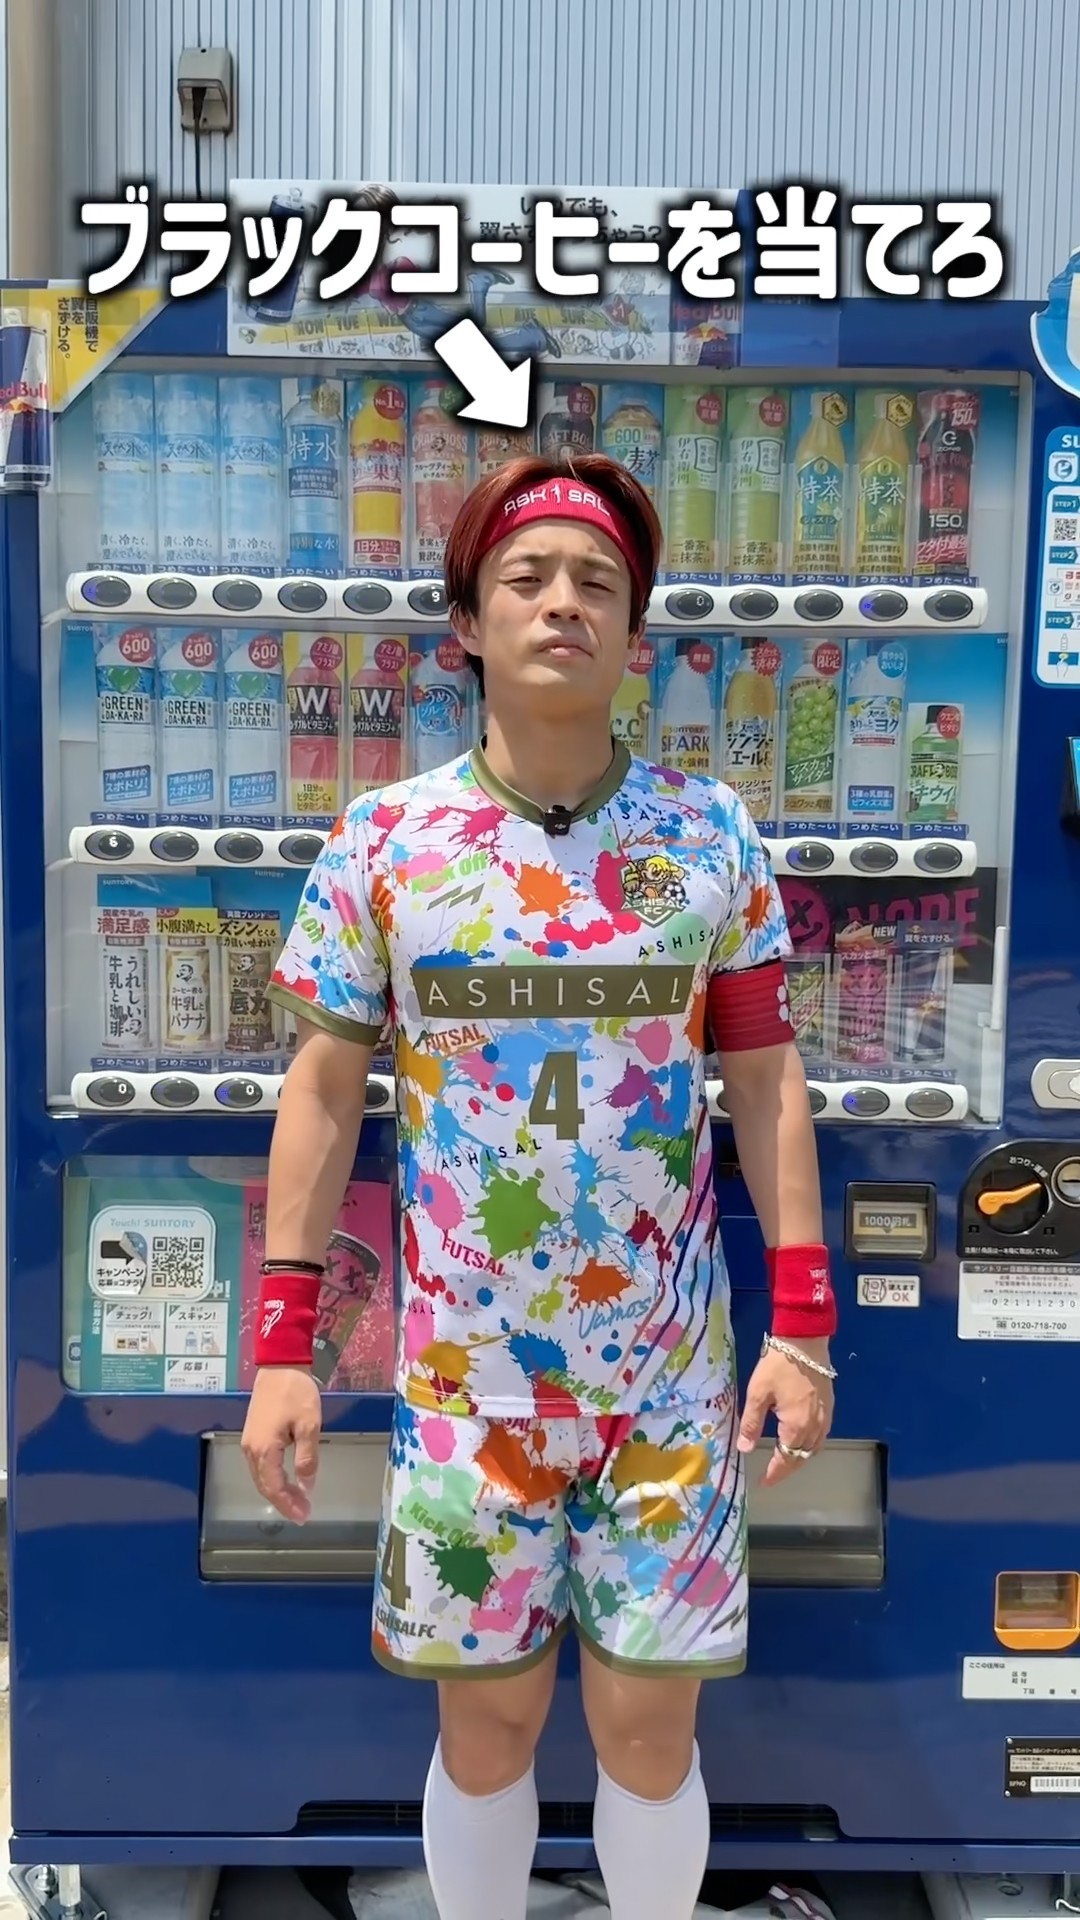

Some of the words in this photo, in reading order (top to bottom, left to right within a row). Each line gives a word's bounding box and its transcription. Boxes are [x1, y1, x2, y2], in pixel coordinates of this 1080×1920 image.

[71, 297, 85, 326] 翼を
[710, 303, 740, 321] Bull
[57, 297, 71, 359] さずける。
[85, 297, 99, 353] 自販機で
[0, 383, 15, 397] ed
[19, 382, 49, 398] Bull
[951, 408, 973, 427] 150
[614, 428, 640, 444] 600
[290, 431, 337, 462] 特水
[677, 437, 691, 485] 伊右衛門
[740, 439, 754, 488] 伊右衛門
[799, 475, 842, 504] 特茶
[860, 476, 905, 505] 特茶
[928, 514, 962, 528] 150
[415, 569, 444, 578] つめた
[432, 591, 440, 602] 9
[122, 638, 149, 655] 600
[184, 643, 212, 659] 600
[251, 644, 278, 660] 600
[816, 655, 840, 669] 限定
[104, 696, 144, 711] GREEN
[167, 700, 206, 715] GREEN
[232, 702, 271, 716] GREEN
[296, 687, 331, 715] W
[360, 689, 394, 717] W
[661, 735, 711, 753] SPARK
[787, 756, 833, 775] マスカット
[105, 777, 149, 794] スポドリ!
[792, 767, 831, 787] サイダー
[168, 782, 211, 797] スポドリ!
[231, 783, 275, 799] スポドリ!
[621, 898, 687, 910] ASHISAL
[643, 907, 662, 915] FC
[97, 917, 150, 934] 満足感
[157, 918, 215, 934] 小腹満たし
[873, 925, 897, 938] NEW
[427, 977, 681, 1007] ASHISAL
[171, 995, 205, 1012] 牛乳と
[171, 1012, 206, 1030] バナナ
[424, 1022, 486, 1052] FUTSAL
[528, 1051, 585, 1141] 4
[441, 1138, 543, 1170] ASHISAL
[143, 1218, 196, 1229] SUNTORY
[442, 1233, 507, 1276] FUTSAL
[96, 1268, 144, 1277] キャンペーン
[891, 1292, 910, 1303] OK
[115, 1311, 152, 1321] チェック!
[178, 1311, 217, 1321] スキャン!
[579, 1297, 651, 1340] Vamos
[1010, 1321, 1068, 1330] 0120-718-700
[408, 1502, 447, 1541] Kick
[378, 1524, 412, 1612] 4
[418, 1624, 437, 1639] FC
